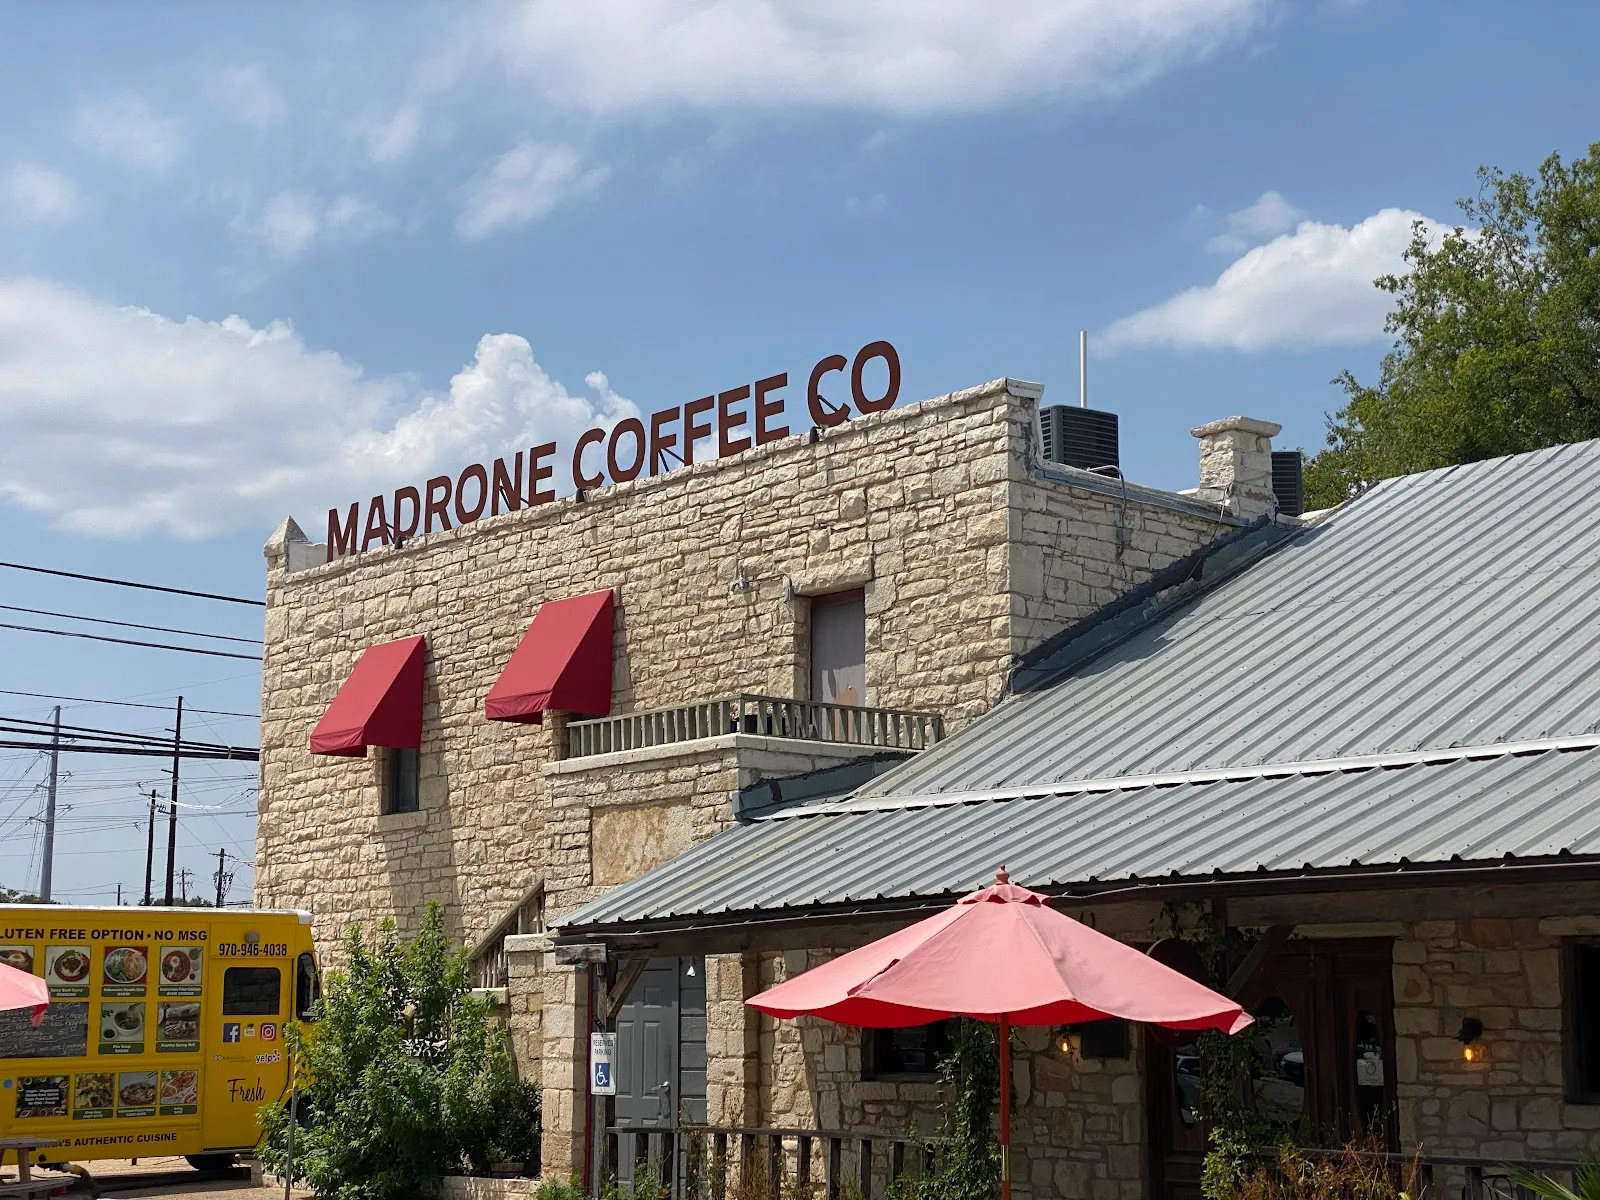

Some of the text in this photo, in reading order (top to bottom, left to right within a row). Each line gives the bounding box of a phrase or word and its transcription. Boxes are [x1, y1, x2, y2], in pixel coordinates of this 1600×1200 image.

[327, 340, 901, 562] MADRONE COFFEE CO
[50, 928, 86, 940] FREE
[91, 929, 144, 941] OPTION
[154, 930, 174, 941] NO
[178, 930, 208, 941] MSG
[219, 943, 287, 956] 970-946-4038
[255, 1053, 273, 1064] yelp
[227, 1077, 265, 1102] Fresh
[74, 1135, 134, 1147] AUTHENTIC
[136, 1132, 177, 1143] CUISINE
